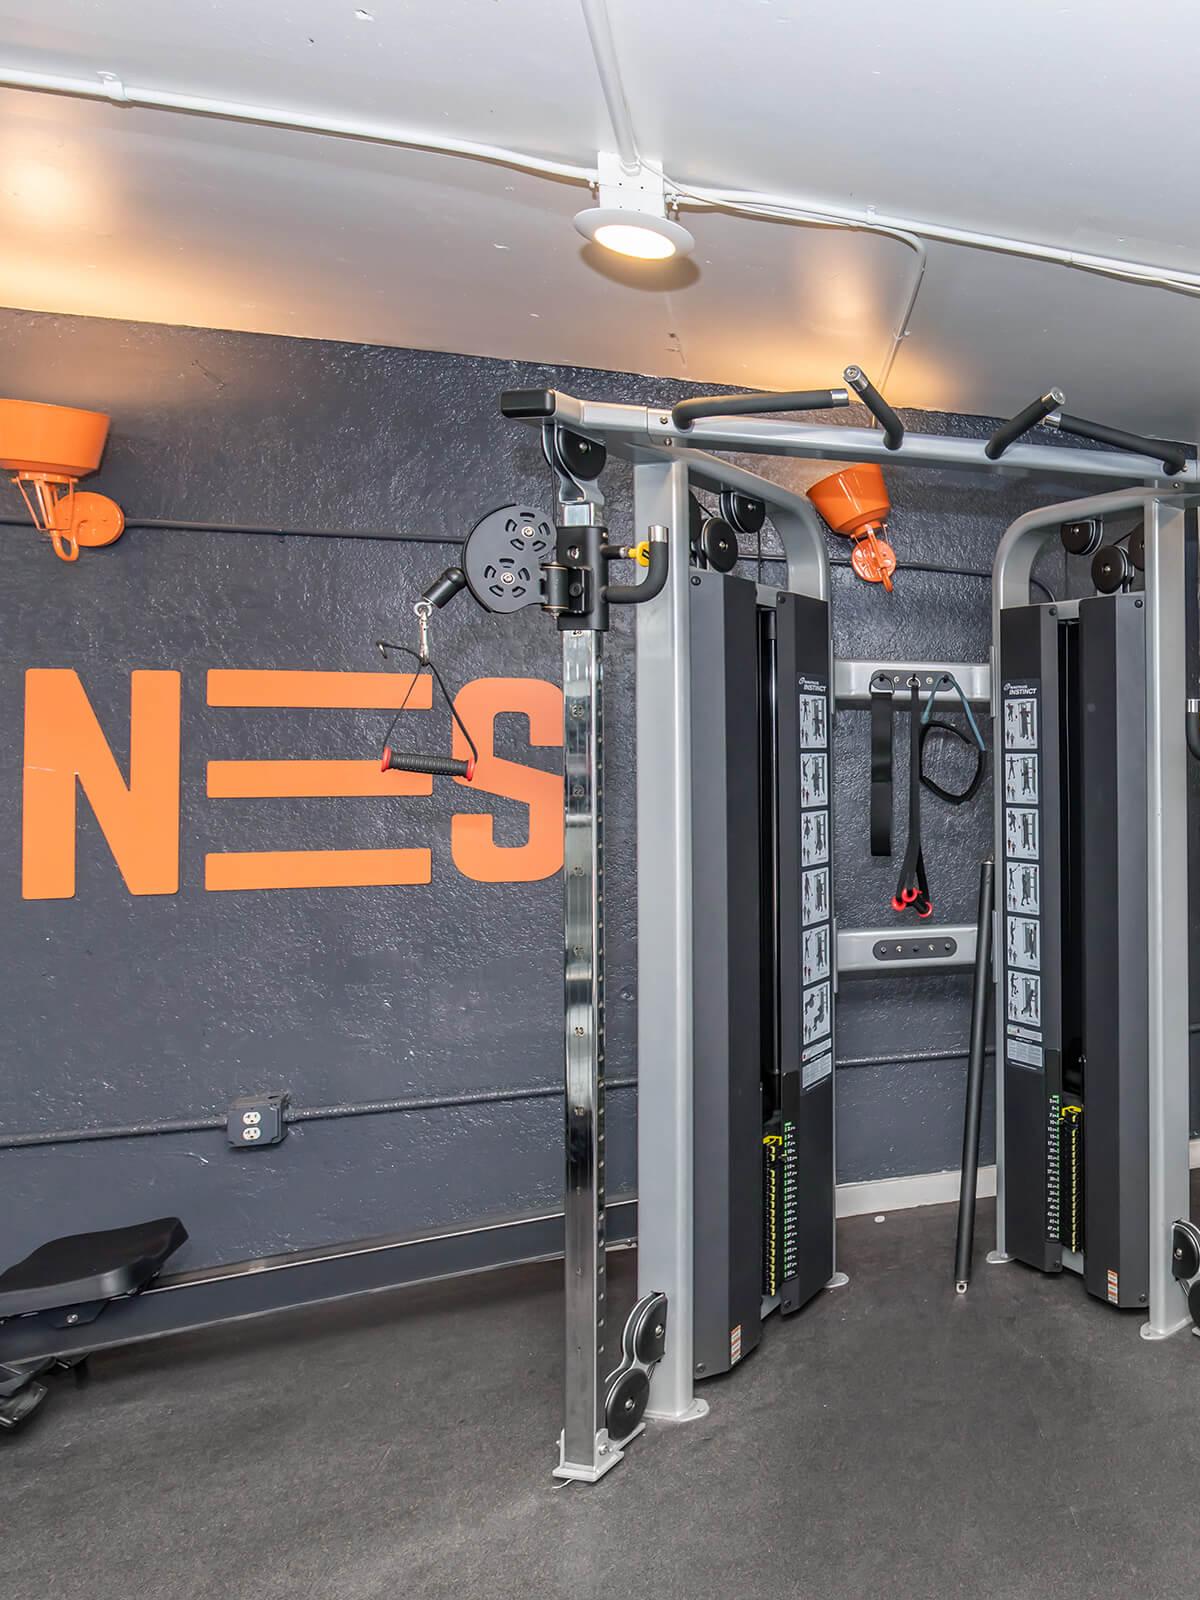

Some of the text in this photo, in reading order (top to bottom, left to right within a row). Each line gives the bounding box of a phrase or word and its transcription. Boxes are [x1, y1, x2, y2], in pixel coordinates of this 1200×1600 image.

[803, 684, 827, 693] INSTINCT
[1008, 687, 1038, 696] INSTINCT
[21, 668, 564, 900] NES
